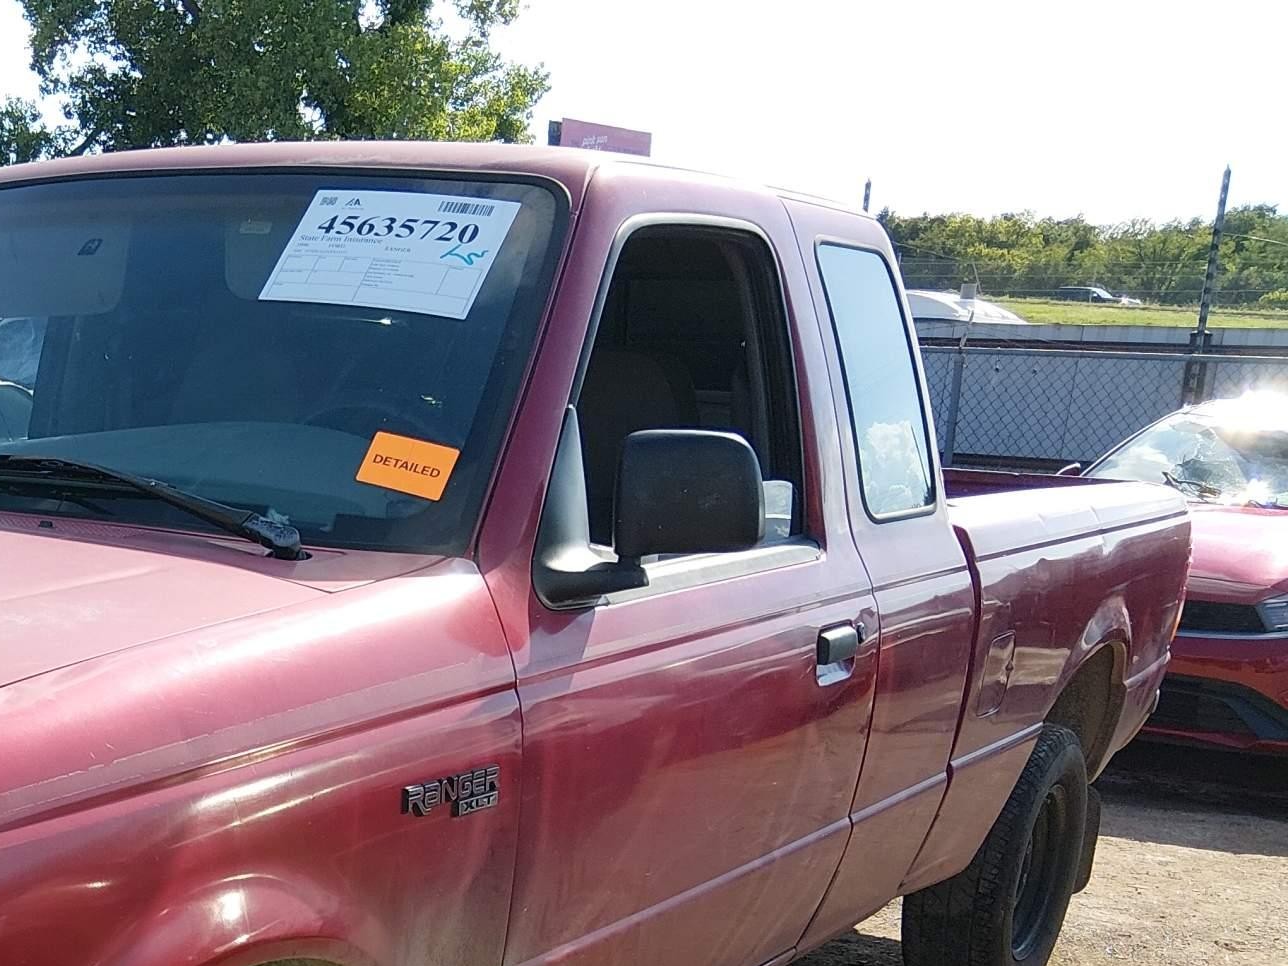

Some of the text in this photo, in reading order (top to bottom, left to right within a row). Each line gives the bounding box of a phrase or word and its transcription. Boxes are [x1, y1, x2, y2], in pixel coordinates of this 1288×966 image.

[299, 234, 384, 245] State Farm Insurance
[317, 213, 480, 245] 45635720
[372, 453, 441, 479] DETAILED
[401, 764, 501, 817] RANGER
[461, 793, 497, 813] XLT
